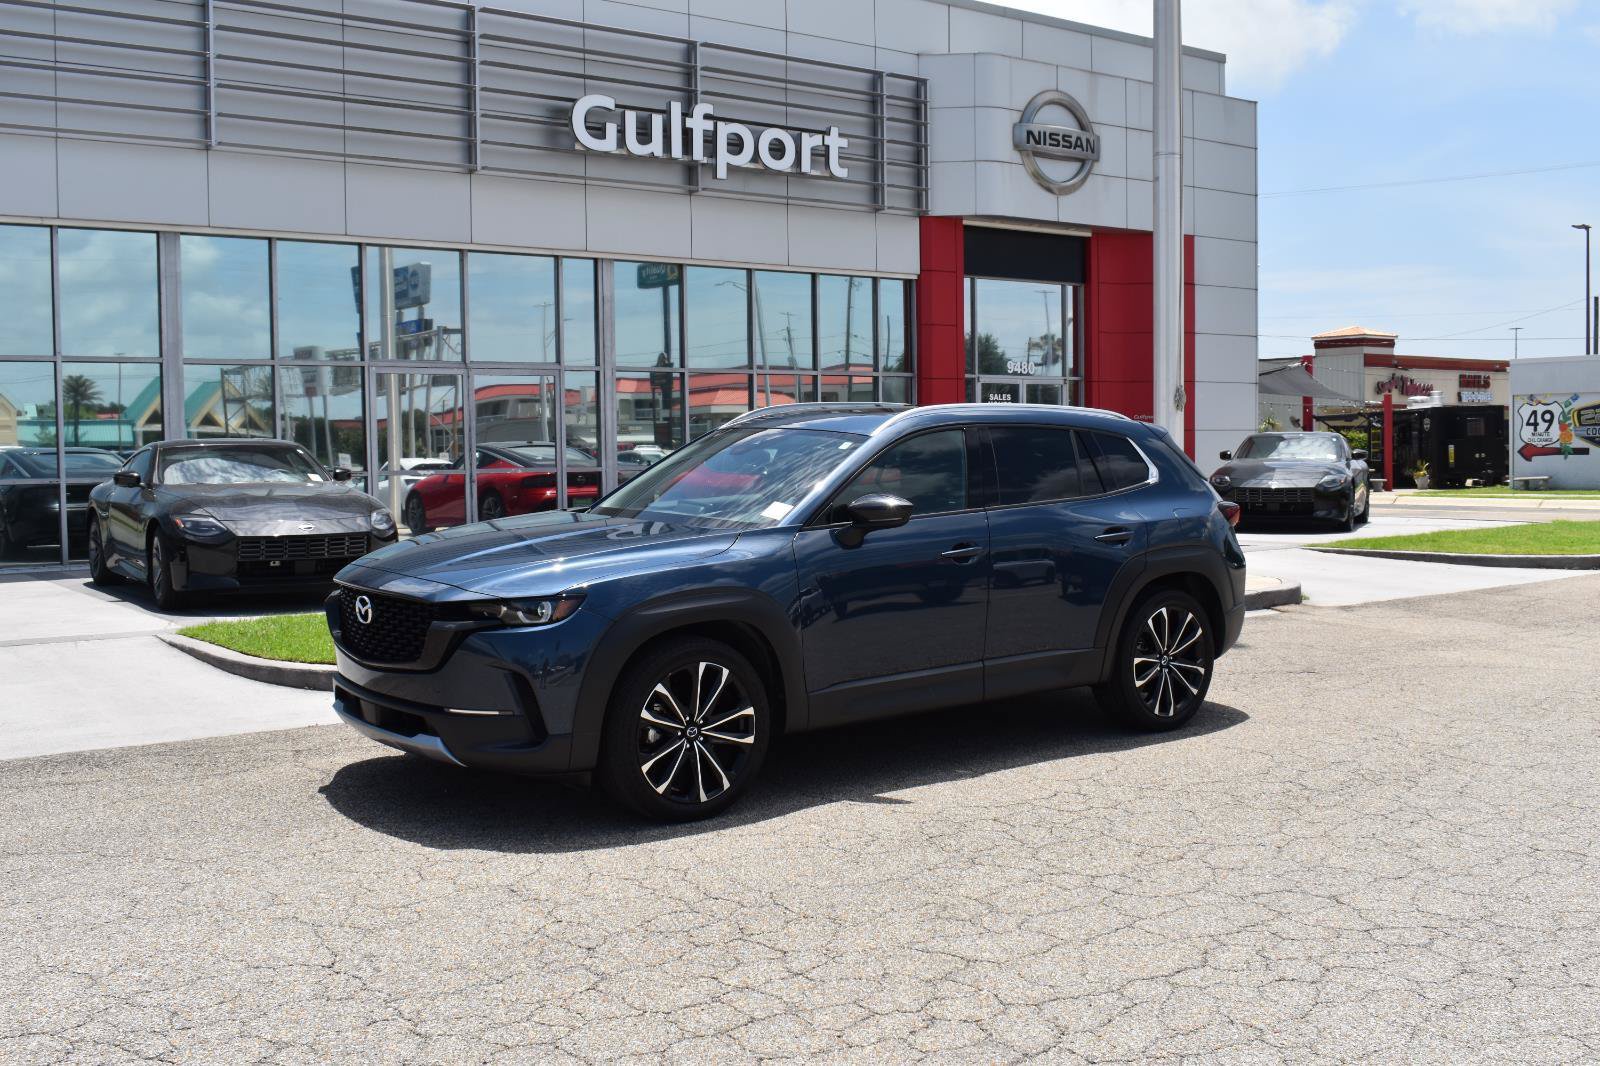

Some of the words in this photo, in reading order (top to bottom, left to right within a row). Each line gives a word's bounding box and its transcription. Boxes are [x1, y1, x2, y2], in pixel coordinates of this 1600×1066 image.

[570, 94, 849, 180] Gulfport
[1025, 129, 1096, 155] NISSAN
[1007, 361, 1035, 374] 9480
[989, 393, 1012, 401] SALES
[1526, 409, 1555, 432] 49
